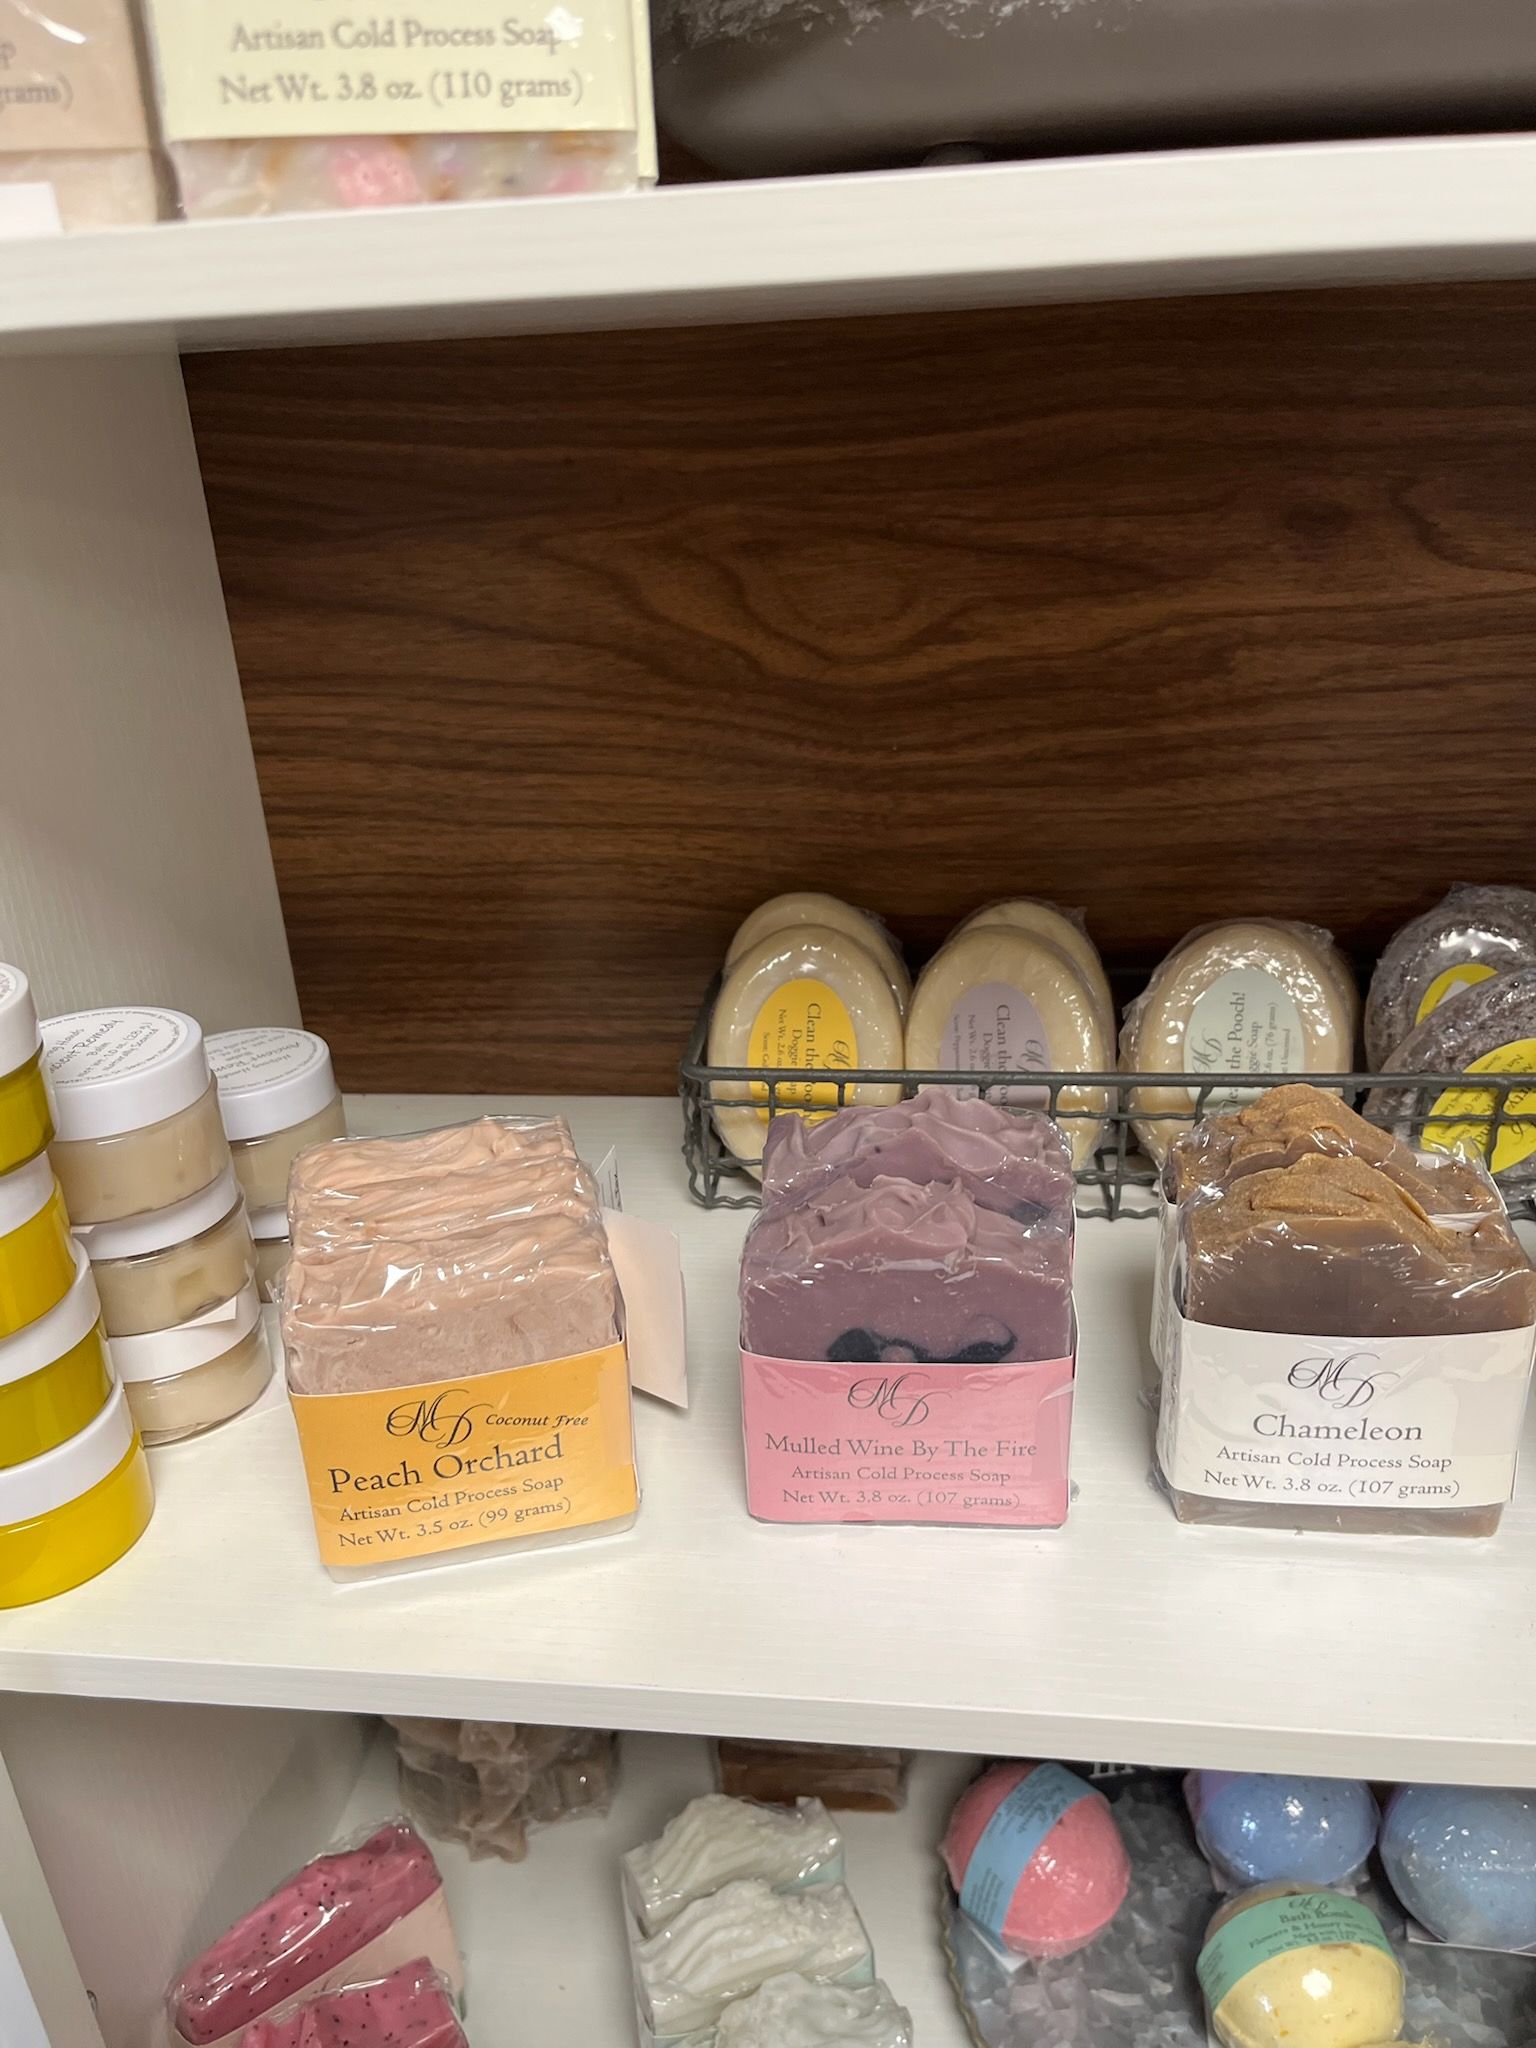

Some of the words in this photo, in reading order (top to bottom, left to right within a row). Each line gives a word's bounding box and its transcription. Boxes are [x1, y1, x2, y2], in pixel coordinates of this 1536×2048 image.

[231, 20, 325, 51] Artisan
[331, 19, 397, 49] Cold
[402, 19, 495, 47] Process
[503, 17, 562, 55] Soap
[0, 72, 73, 113] rams)
[218, 72, 273, 104] Net
[275, 73, 328, 101] Wt.
[337, 72, 377, 100] 3.8
[386, 80, 421, 100] oz.
[430, 69, 492, 107] (110
[500, 69, 583, 108] grams)
[777, 1008, 787, 1024] Net
[805, 1003, 821, 1042] Clean
[997, 1004, 1010, 1045] Clean
[1227, 991, 1246, 1042] Pooch!
[1268, 1002, 1279, 1030] grams)
[788, 1029, 802, 1066] Doggie
[1247, 1022, 1262, 1048] Soap
[1266, 1032, 1276, 1046] (76
[805, 1048, 820, 1069] the
[980, 1033, 993, 1069] Doggie
[1225, 1047, 1242, 1070] the
[486, 1413, 549, 1428] Coconut
[552, 1413, 590, 1429] Free
[1253, 1413, 1423, 1441] Chameleon
[765, 1433, 840, 1455] Mulled
[847, 1439, 904, 1456] Wine
[912, 1440, 939, 1462] By
[944, 1440, 988, 1457] The
[995, 1440, 1037, 1457] Fire
[1216, 1446, 1280, 1465] Artisan
[1288, 1452, 1331, 1467] Cold
[1338, 1454, 1402, 1469] Process
[1409, 1455, 1452, 1472] Soap
[328, 1462, 422, 1494] Peach
[433, 1433, 565, 1480] Orchard
[791, 1466, 850, 1480] Artisan
[856, 1467, 897, 1480] Cold
[903, 1468, 964, 1481] Process
[970, 1468, 1011, 1486] Soap
[1204, 1470, 1238, 1487] Net
[1242, 1474, 1276, 1490] Wt.
[1283, 1477, 1311, 1492] 3.8
[1317, 1482, 1342, 1494] oz.
[1349, 1479, 1393, 1497] (107
[1399, 1480, 1460, 1498] grams)
[340, 1505, 401, 1522] Artisan
[407, 1497, 450, 1514] Cold
[455, 1484, 518, 1506] Process
[523, 1476, 565, 1495] Soap
[783, 1489, 814, 1504] Net
[818, 1490, 851, 1503] Wt.
[856, 1490, 881, 1503] 3.8
[887, 1494, 911, 1504] oz.
[917, 1490, 957, 1506] (107
[963, 1492, 1021, 1509] grams)
[339, 1532, 373, 1548] Net
[377, 1527, 411, 1543] Wt.
[417, 1520, 443, 1537] 3.5
[449, 1517, 474, 1531] oz.
[479, 1508, 509, 1529] (99
[515, 1497, 572, 1523] grams)
[1279, 1911, 1312, 1924] Bath
[1315, 1910, 1354, 1920] Bomb
